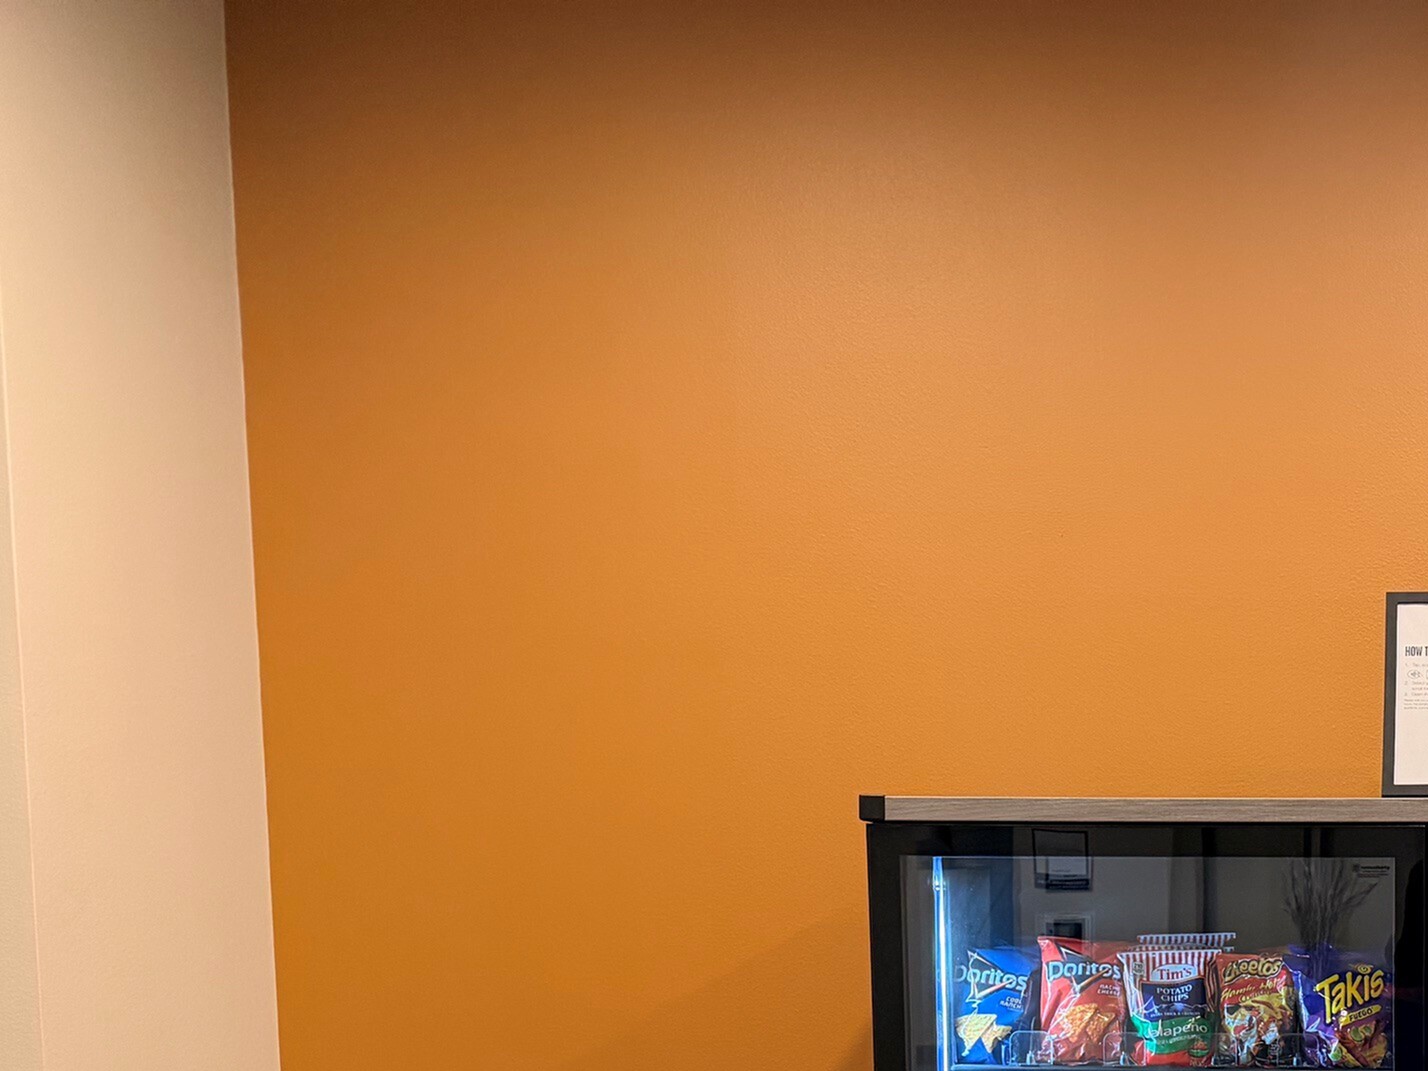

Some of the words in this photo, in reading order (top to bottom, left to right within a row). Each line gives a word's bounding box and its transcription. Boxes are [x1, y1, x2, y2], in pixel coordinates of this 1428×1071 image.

[1404, 645, 1423, 657] HOW
[1047, 960, 1122, 981] Doritos
[1156, 966, 1192, 980] Tim's
[953, 964, 1029, 992] Doritos
[1156, 984, 1193, 995] POTATO
[1315, 966, 1384, 1025] Takis
[1160, 992, 1189, 1002] CHIPS
[1349, 1008, 1373, 1021] FUEGO
